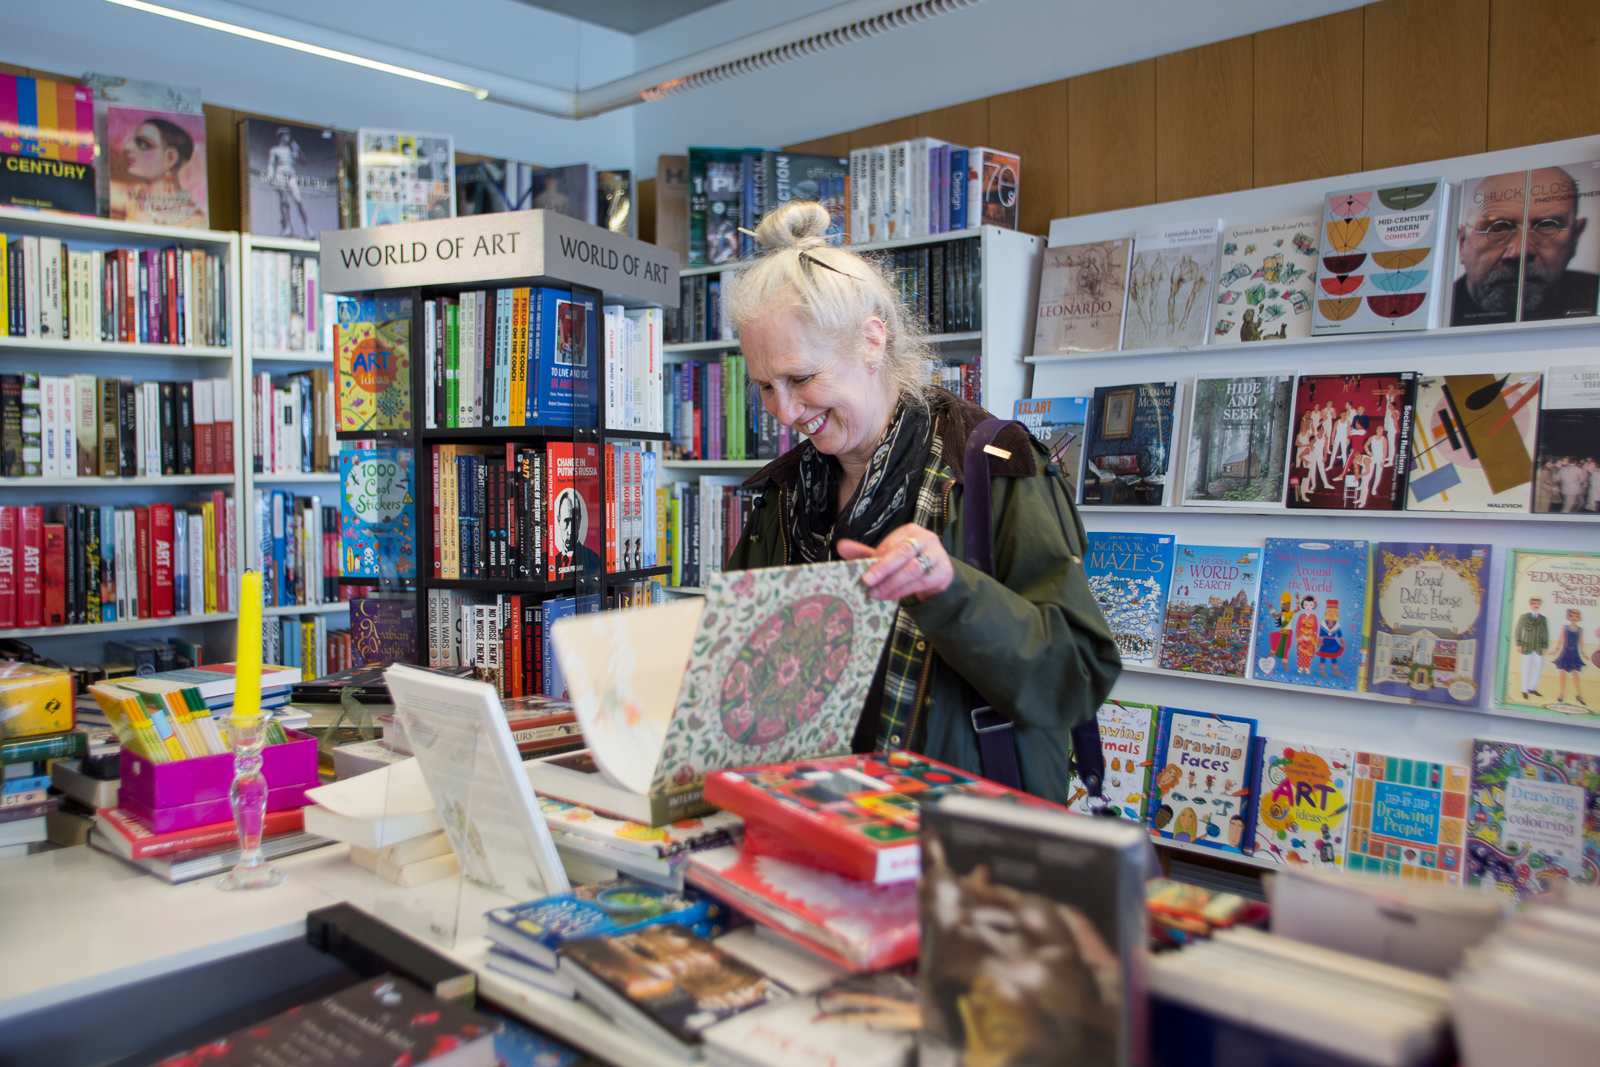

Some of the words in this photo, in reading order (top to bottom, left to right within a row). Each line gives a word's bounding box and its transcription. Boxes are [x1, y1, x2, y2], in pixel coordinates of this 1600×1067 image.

[6, 156, 86, 180] CENTURY
[1473, 187, 1524, 204] CHUCK
[1530, 179, 1580, 197] CLOSE
[1534, 190, 1600, 205] PHOTOGRAPHER
[1377, 214, 1430, 226] MID-CENTURY
[1386, 223, 1420, 233] MODERN
[1164, 228, 1190, 239] Leonardo
[1199, 226, 1213, 235] Vinci
[1232, 228, 1254, 238] Quentin
[1255, 226, 1270, 234] Blake
[1384, 232, 1420, 241] COMPLETE
[340, 241, 427, 269] WORLD
[436, 237, 465, 260] OF
[473, 231, 521, 257] ART
[559, 234, 619, 270] WORLD
[622, 254, 640, 277] OF
[643, 261, 669, 284] ART
[512, 297, 520, 327] FREUD
[520, 297, 528, 327] FREUD
[1039, 300, 1112, 318] LEONARDO
[512, 327, 518, 339] ON
[520, 327, 526, 339] ON
[353, 351, 392, 373] ART
[360, 373, 389, 386] ideas
[551, 367, 558, 377] TO
[558, 368, 569, 378] LIVE
[570, 369, 580, 378] AND
[581, 370, 589, 379] DIE
[551, 378, 558, 389] IN
[559, 379, 588, 391] AMERICA
[1138, 387, 1171, 396] WILLIAM
[1226, 382, 1261, 394] HIDE
[1017, 402, 1032, 414] XXL
[1034, 401, 1053, 414] ART
[1137, 397, 1171, 408] MORRIS
[1227, 395, 1257, 407] AND
[1016, 414, 1043, 427] WHEN
[1223, 408, 1259, 420] SEEK
[1400, 405, 1412, 439] Socialist
[1031, 426, 1052, 440] TISTS
[580, 458, 586, 467] IN
[1397, 440, 1408, 475] Realisms
[360, 463, 397, 478] 1000
[522, 458, 530, 479] 24/7
[557, 467, 578, 476] PUTIN'S
[579, 467, 598, 476] RUSSIA
[633, 452, 641, 483] NORTH
[364, 478, 393, 497] Cool
[355, 494, 401, 514] Stickers
[633, 486, 641, 516] KOREA
[656, 495, 664, 539] COLOR
[155, 539, 171, 568] ART
[1094, 540, 1111, 551] BIG
[1111, 541, 1145, 553] BOOK
[1145, 542, 1163, 554] OF
[24, 545, 40, 575] ART
[1090, 552, 1165, 573] MAZES
[1198, 557, 1214, 565] THE
[1215, 558, 1232, 566] GREAT
[1275, 551, 1300, 562] Sticker
[1301, 553, 1320, 565] Dolly
[1320, 554, 1351, 567] Dressing
[1190, 564, 1239, 580] WORLD
[1291, 563, 1332, 577] Around
[1193, 579, 1232, 591] SEARCH
[1288, 577, 1303, 590] the
[1302, 577, 1333, 593] World
[1414, 570, 1445, 590] Royal
[1527, 570, 1600, 589] EDWARD
[1399, 587, 1429, 605] Doll's
[1431, 589, 1463, 608] House
[1551, 590, 1597, 607] Fashion
[1578, 585, 1600, 598] 192
[430, 597, 438, 625] SCHOOL
[441, 597, 450, 625] SCHOOL
[476, 608, 485, 618] NO
[488, 608, 497, 618] NO
[1401, 605, 1429, 620] Sticker
[1430, 608, 1454, 623] Book
[430, 626, 438, 649] WARS
[441, 626, 450, 649] WARS
[476, 619, 485, 641] WORSE
[488, 619, 497, 641] WORSE
[476, 643, 485, 664] ENEMY
[488, 643, 497, 665] ENEMY
[1099, 724, 1145, 743] awing
[1100, 737, 1141, 755] imals
[1172, 734, 1242, 761] Drawing
[1180, 752, 1230, 773] Faces
[1294, 760, 1318, 771] Usborne
[1285, 766, 1310, 777] Complete
[1310, 770, 1326, 780] Book
[669, 790, 704, 807] INTERW
[1271, 777, 1337, 812] ART
[1384, 793, 1430, 810] STEP-BY-STEP
[1511, 785, 1579, 812] Drawing,
[1295, 808, 1322, 823] ideas
[1377, 800, 1434, 830] Drawing
[1510, 800, 1577, 823] doodling
[1384, 815, 1426, 837] People
[1509, 814, 1574, 837] colouring
